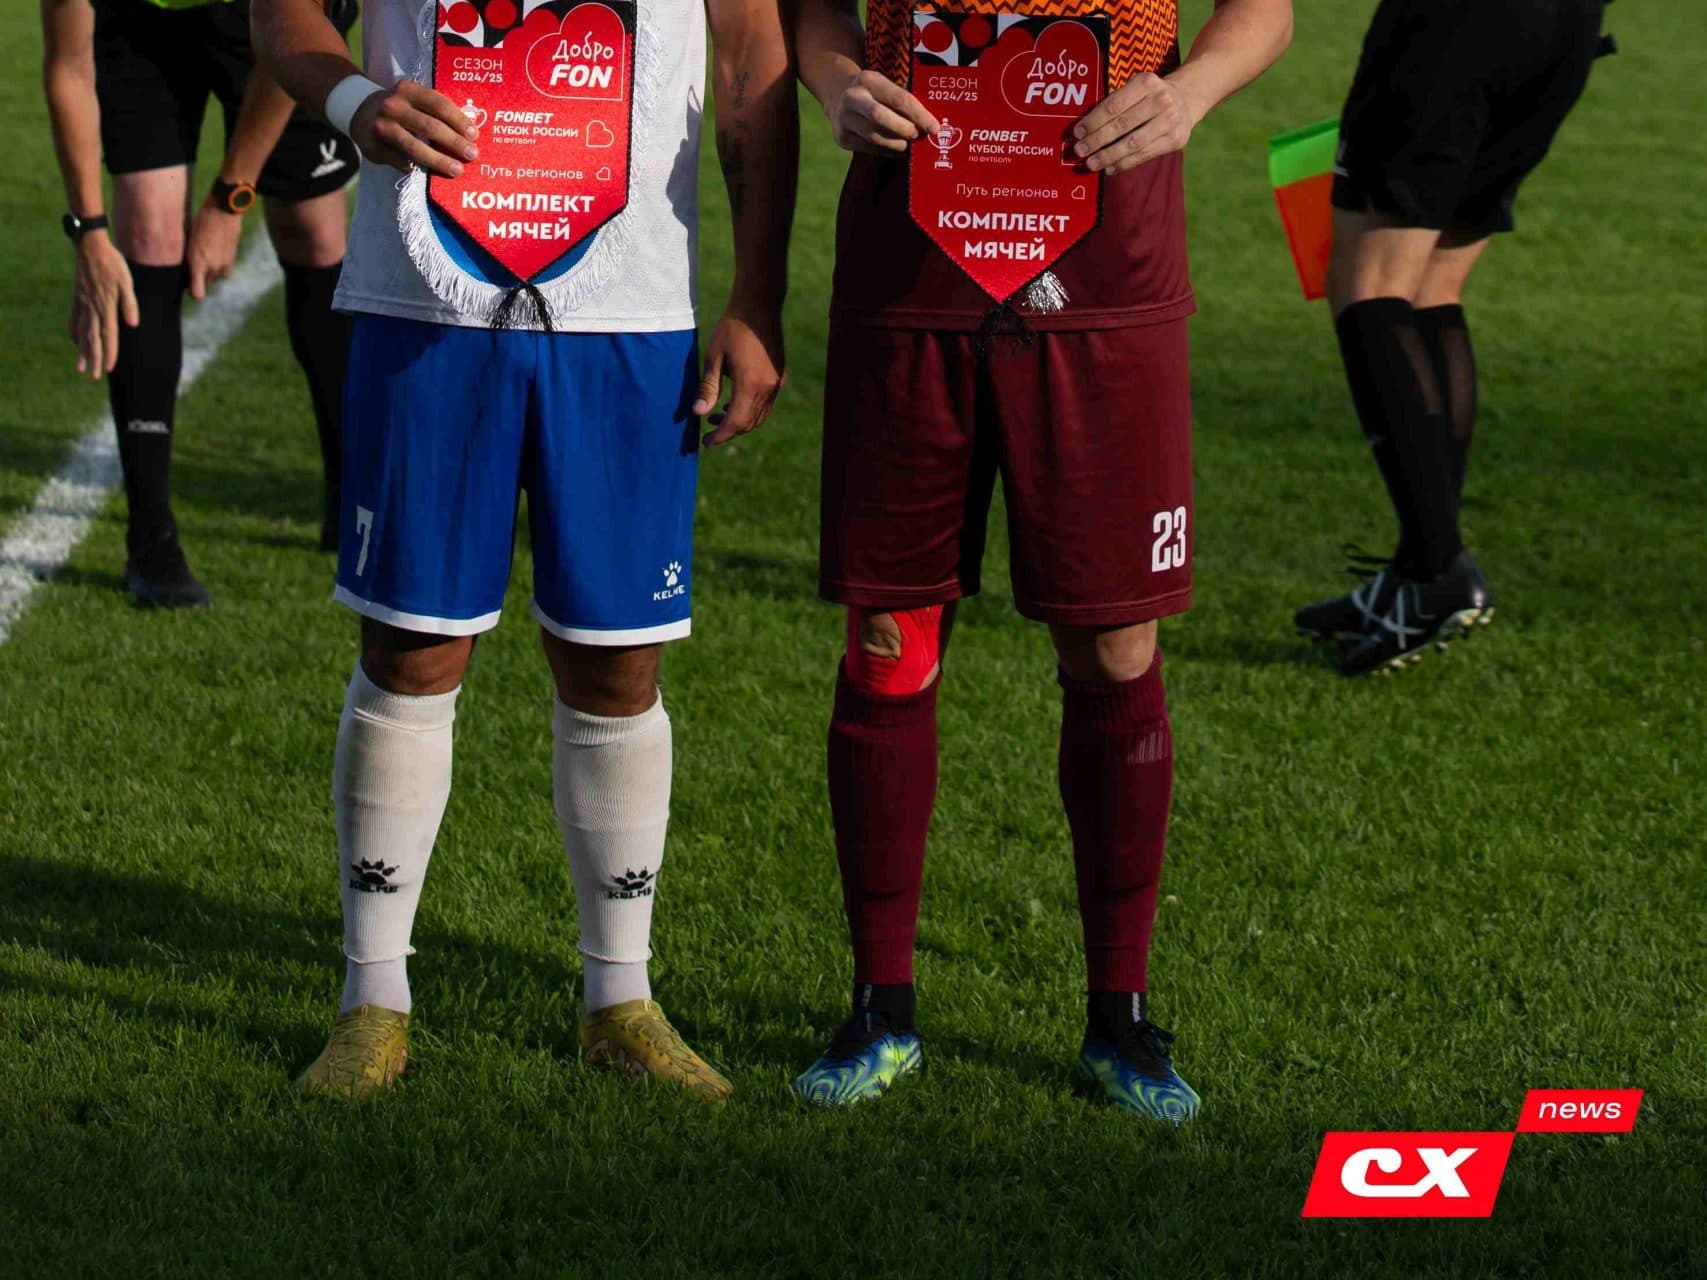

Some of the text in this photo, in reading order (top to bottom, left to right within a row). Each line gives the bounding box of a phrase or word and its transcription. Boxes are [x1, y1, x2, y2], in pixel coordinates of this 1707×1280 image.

[552, 32, 615, 62] Добро
[453, 57, 503, 71] СЕЗОН
[1026, 49, 1089, 80] Добро
[452, 71, 503, 83] 2024/25
[549, 64, 614, 88] FON
[928, 76, 978, 90] СЕЗОН
[928, 90, 978, 101] 2024/25
[1024, 82, 1088, 106] FON
[494, 110, 554, 124] FONBET
[493, 125, 579, 138] КУБОК РОССИИ
[969, 129, 1029, 143] FONBET
[969, 144, 1054, 156] КУБОК РОССИИ
[480, 164, 584, 182] Путь регионов
[956, 183, 1059, 200] Путь регионов
[461, 191, 595, 213] КОМПЛЕКТ
[488, 218, 570, 241] МЯЧЕЙ
[938, 210, 1070, 233] КОМПЛЕКТ
[964, 238, 1046, 261] МЯЧЕЙ
[355, 504, 374, 577] 7
[1151, 505, 1187, 573] 23
[653, 584, 686, 601] KELME
